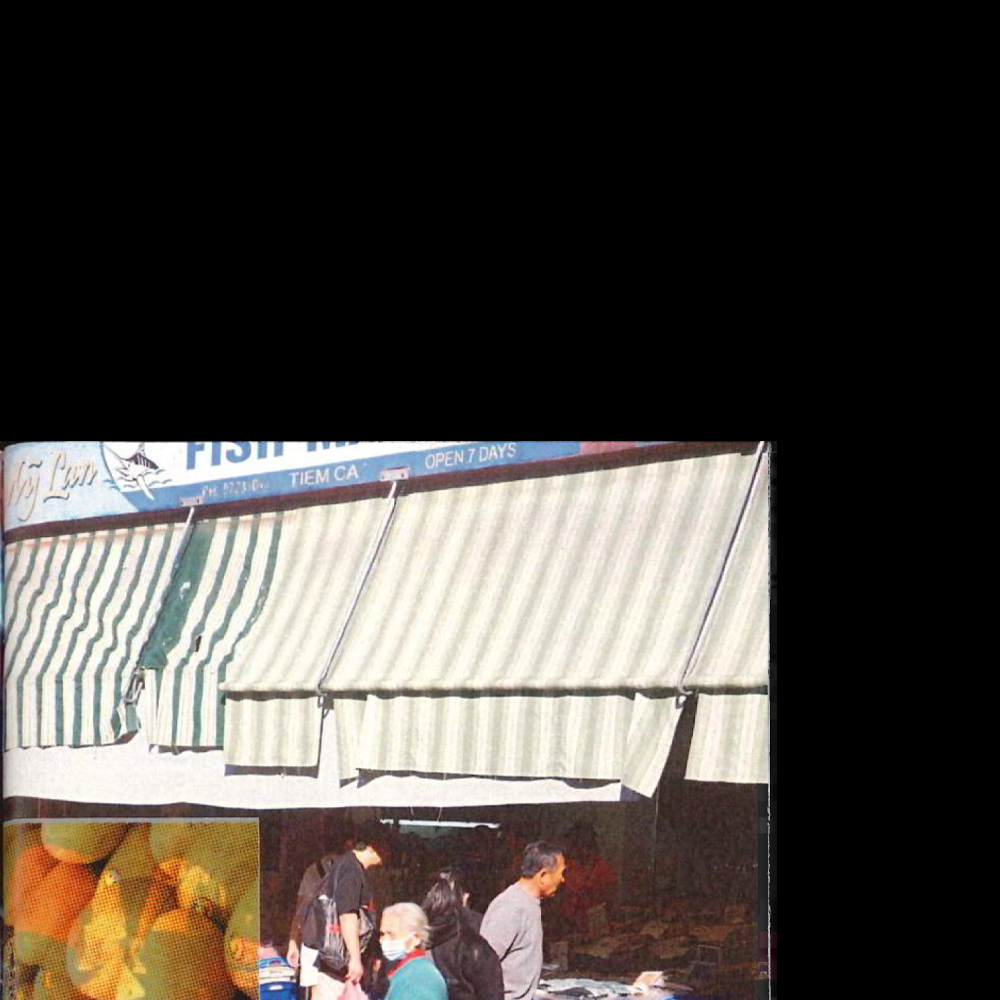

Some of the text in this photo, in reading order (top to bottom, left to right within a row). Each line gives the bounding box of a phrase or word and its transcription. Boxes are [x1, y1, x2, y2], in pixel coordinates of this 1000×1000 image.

[425, 441, 516, 469] OPEN 7 DAYS
[289, 468, 330, 487] TIEM
[334, 464, 358, 481] CA
